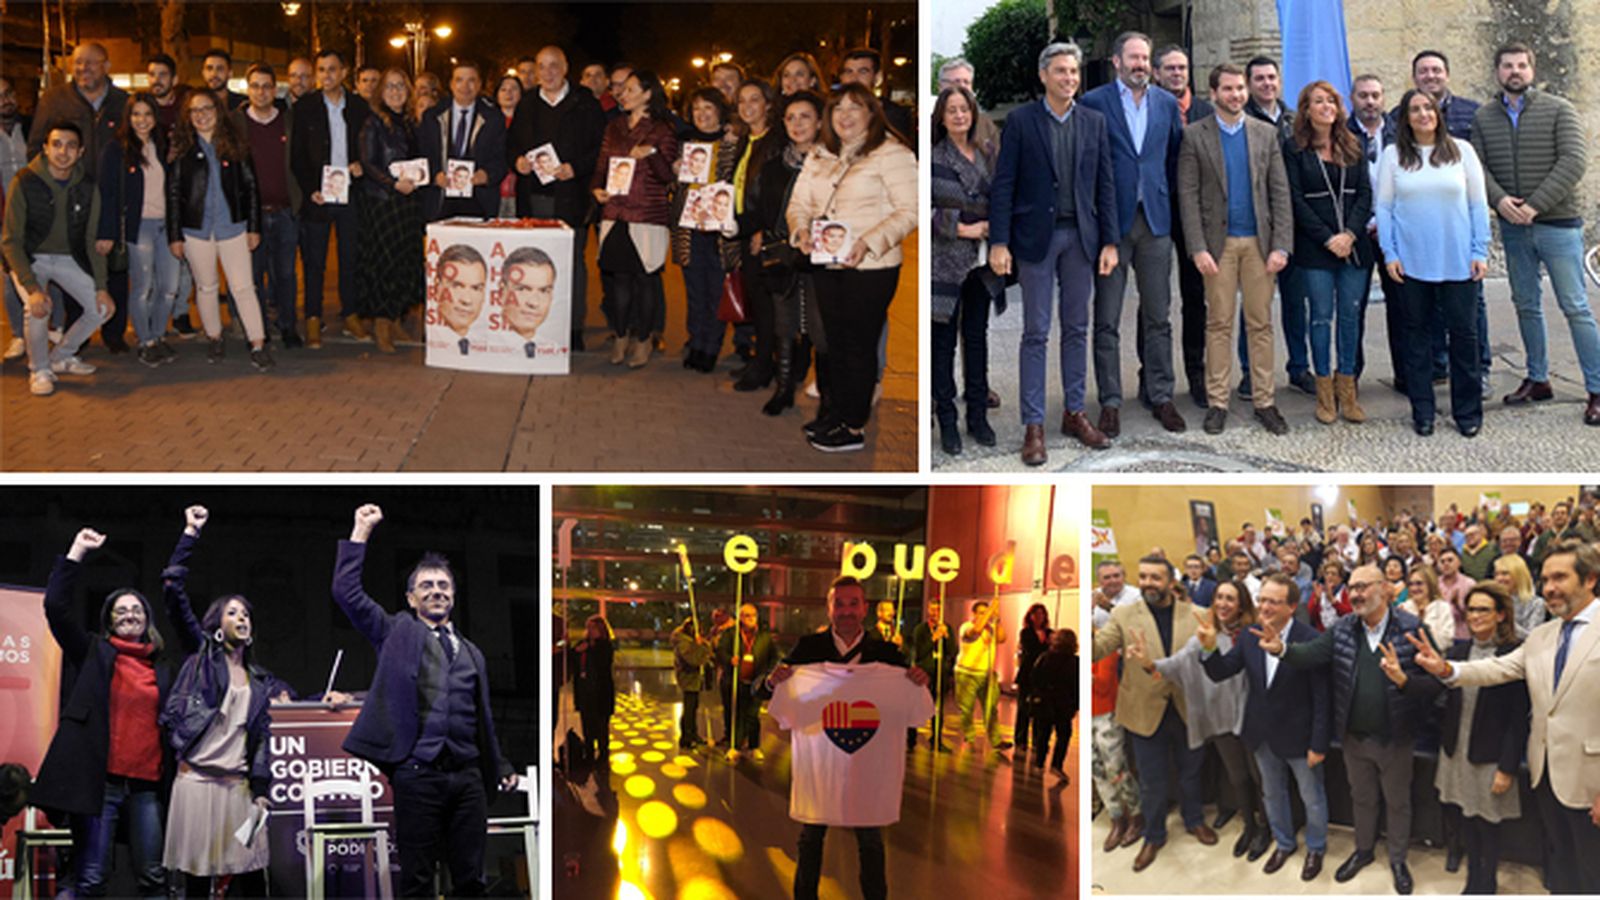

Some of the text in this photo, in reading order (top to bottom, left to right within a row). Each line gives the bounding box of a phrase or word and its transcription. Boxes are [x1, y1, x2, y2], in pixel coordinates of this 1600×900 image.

[428, 238, 440, 254] A
[491, 242, 506, 258] A
[269, 736, 305, 755] UN
